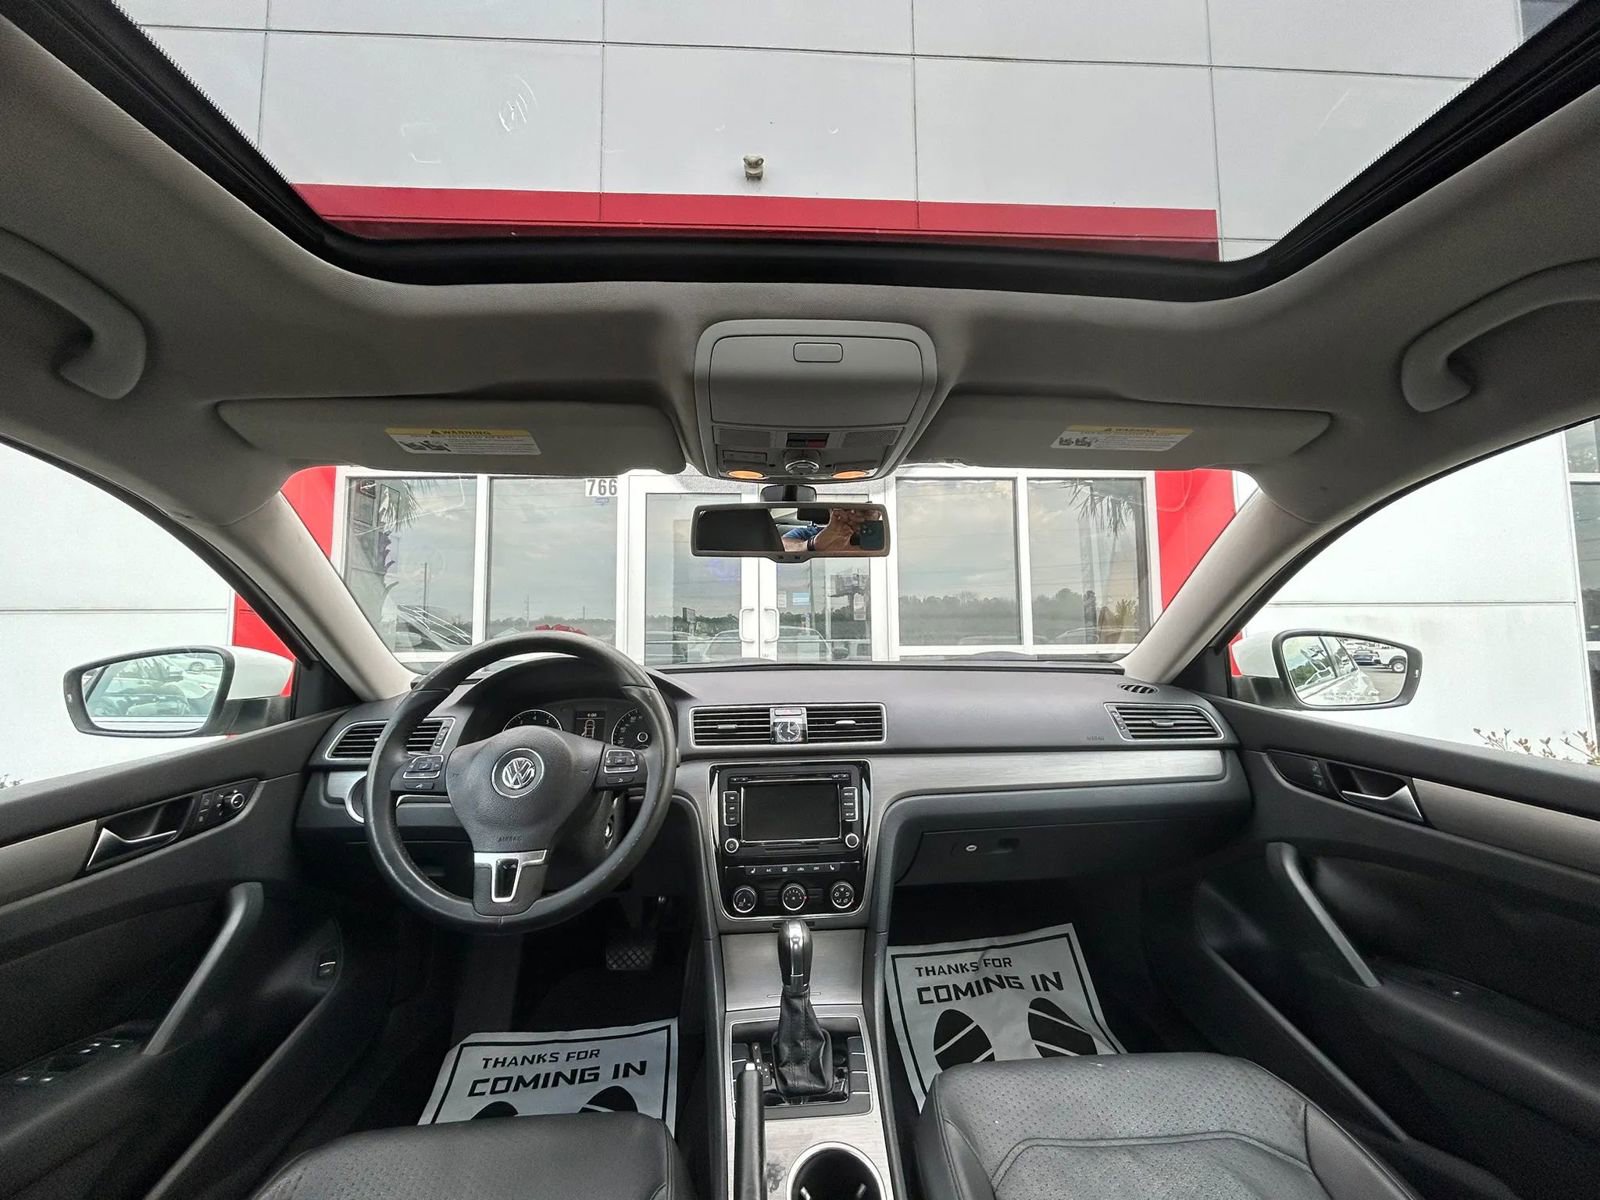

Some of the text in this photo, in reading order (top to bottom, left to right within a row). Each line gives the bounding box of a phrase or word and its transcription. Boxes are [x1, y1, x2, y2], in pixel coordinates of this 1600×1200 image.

[587, 479, 617, 496] 766
[502, 757, 536, 789] VW
[915, 957, 1012, 977] THANKS FOR
[916, 971, 1065, 1005] COMING IN
[482, 1049, 600, 1069] THANKS FOR
[467, 1060, 647, 1097] COMING IN
